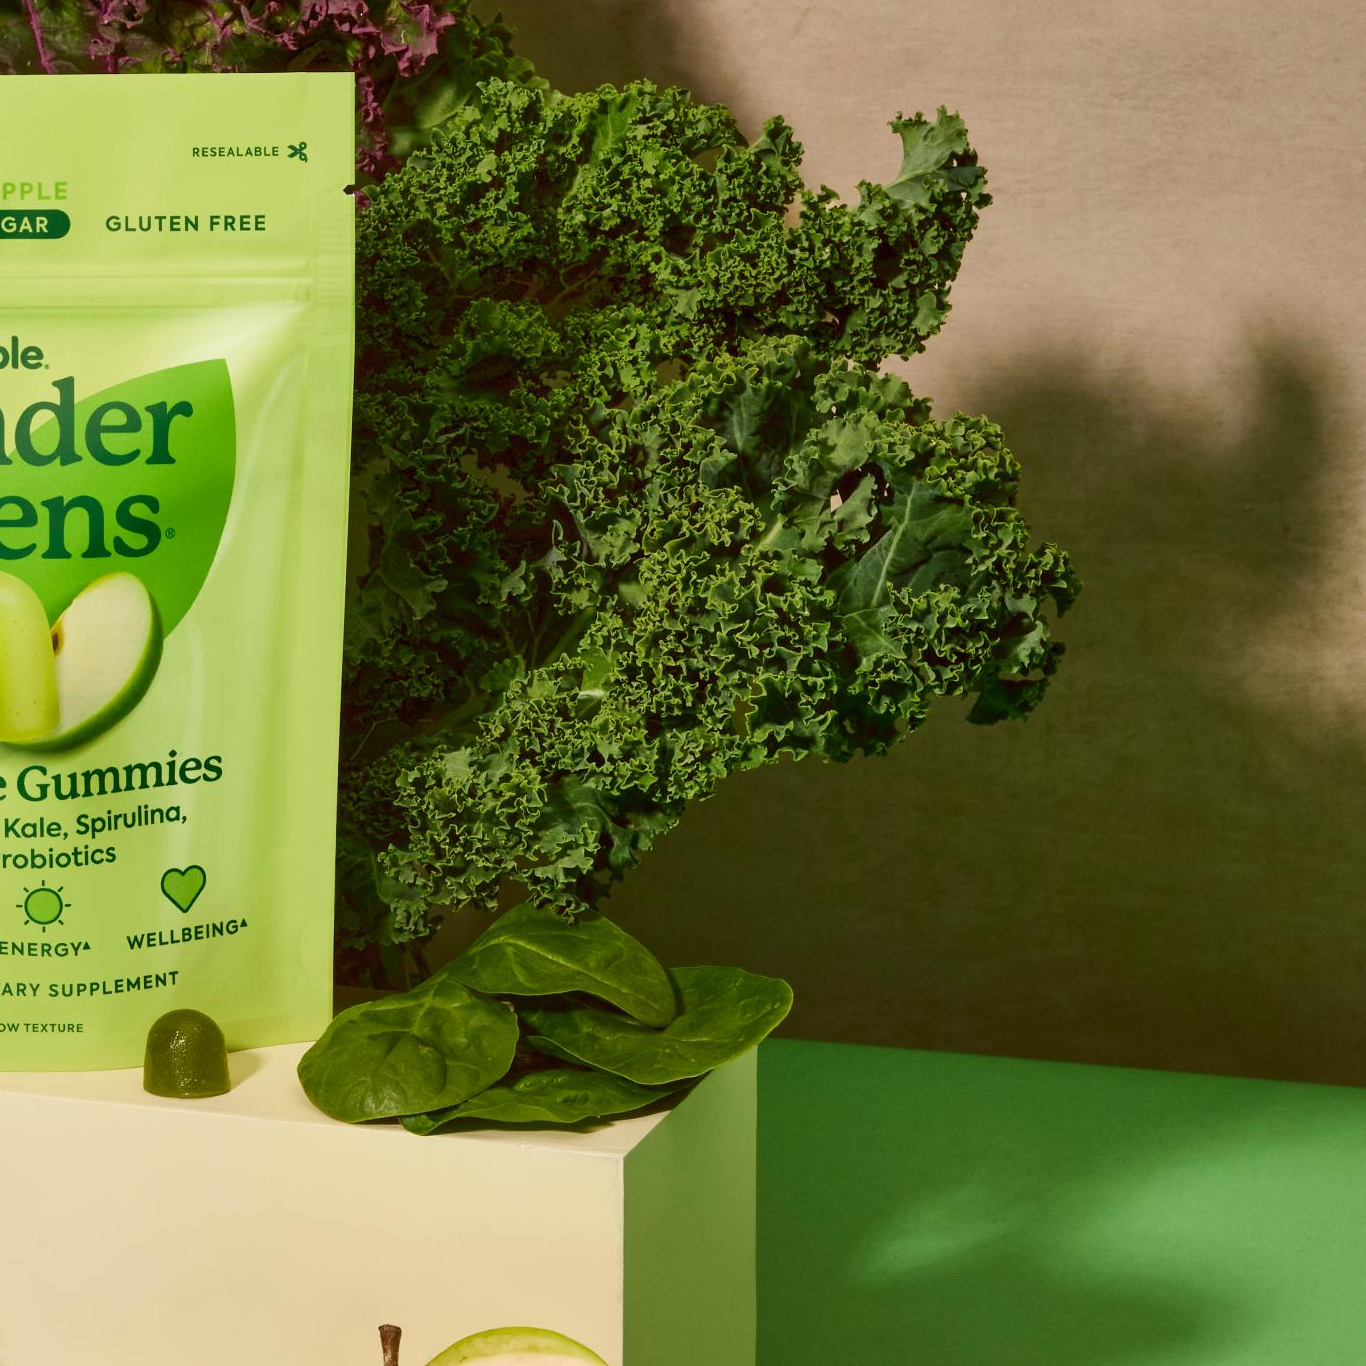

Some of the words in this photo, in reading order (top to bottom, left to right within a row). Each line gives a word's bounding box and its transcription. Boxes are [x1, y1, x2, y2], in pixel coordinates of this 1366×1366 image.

[192, 146, 279, 157] RESEALABLE
[105, 215, 200, 233] GLUTEN
[209, 215, 266, 232] FREE
[17, 749, 222, 802] Gummies
[4, 816, 69, 841] Kale,
[75, 804, 188, 839] Spirulina,
[126, 920, 240, 950] WELLBEING
[49, 971, 179, 997] SUPPLEMENT
[23, 1023, 84, 1033] TEXTURE
